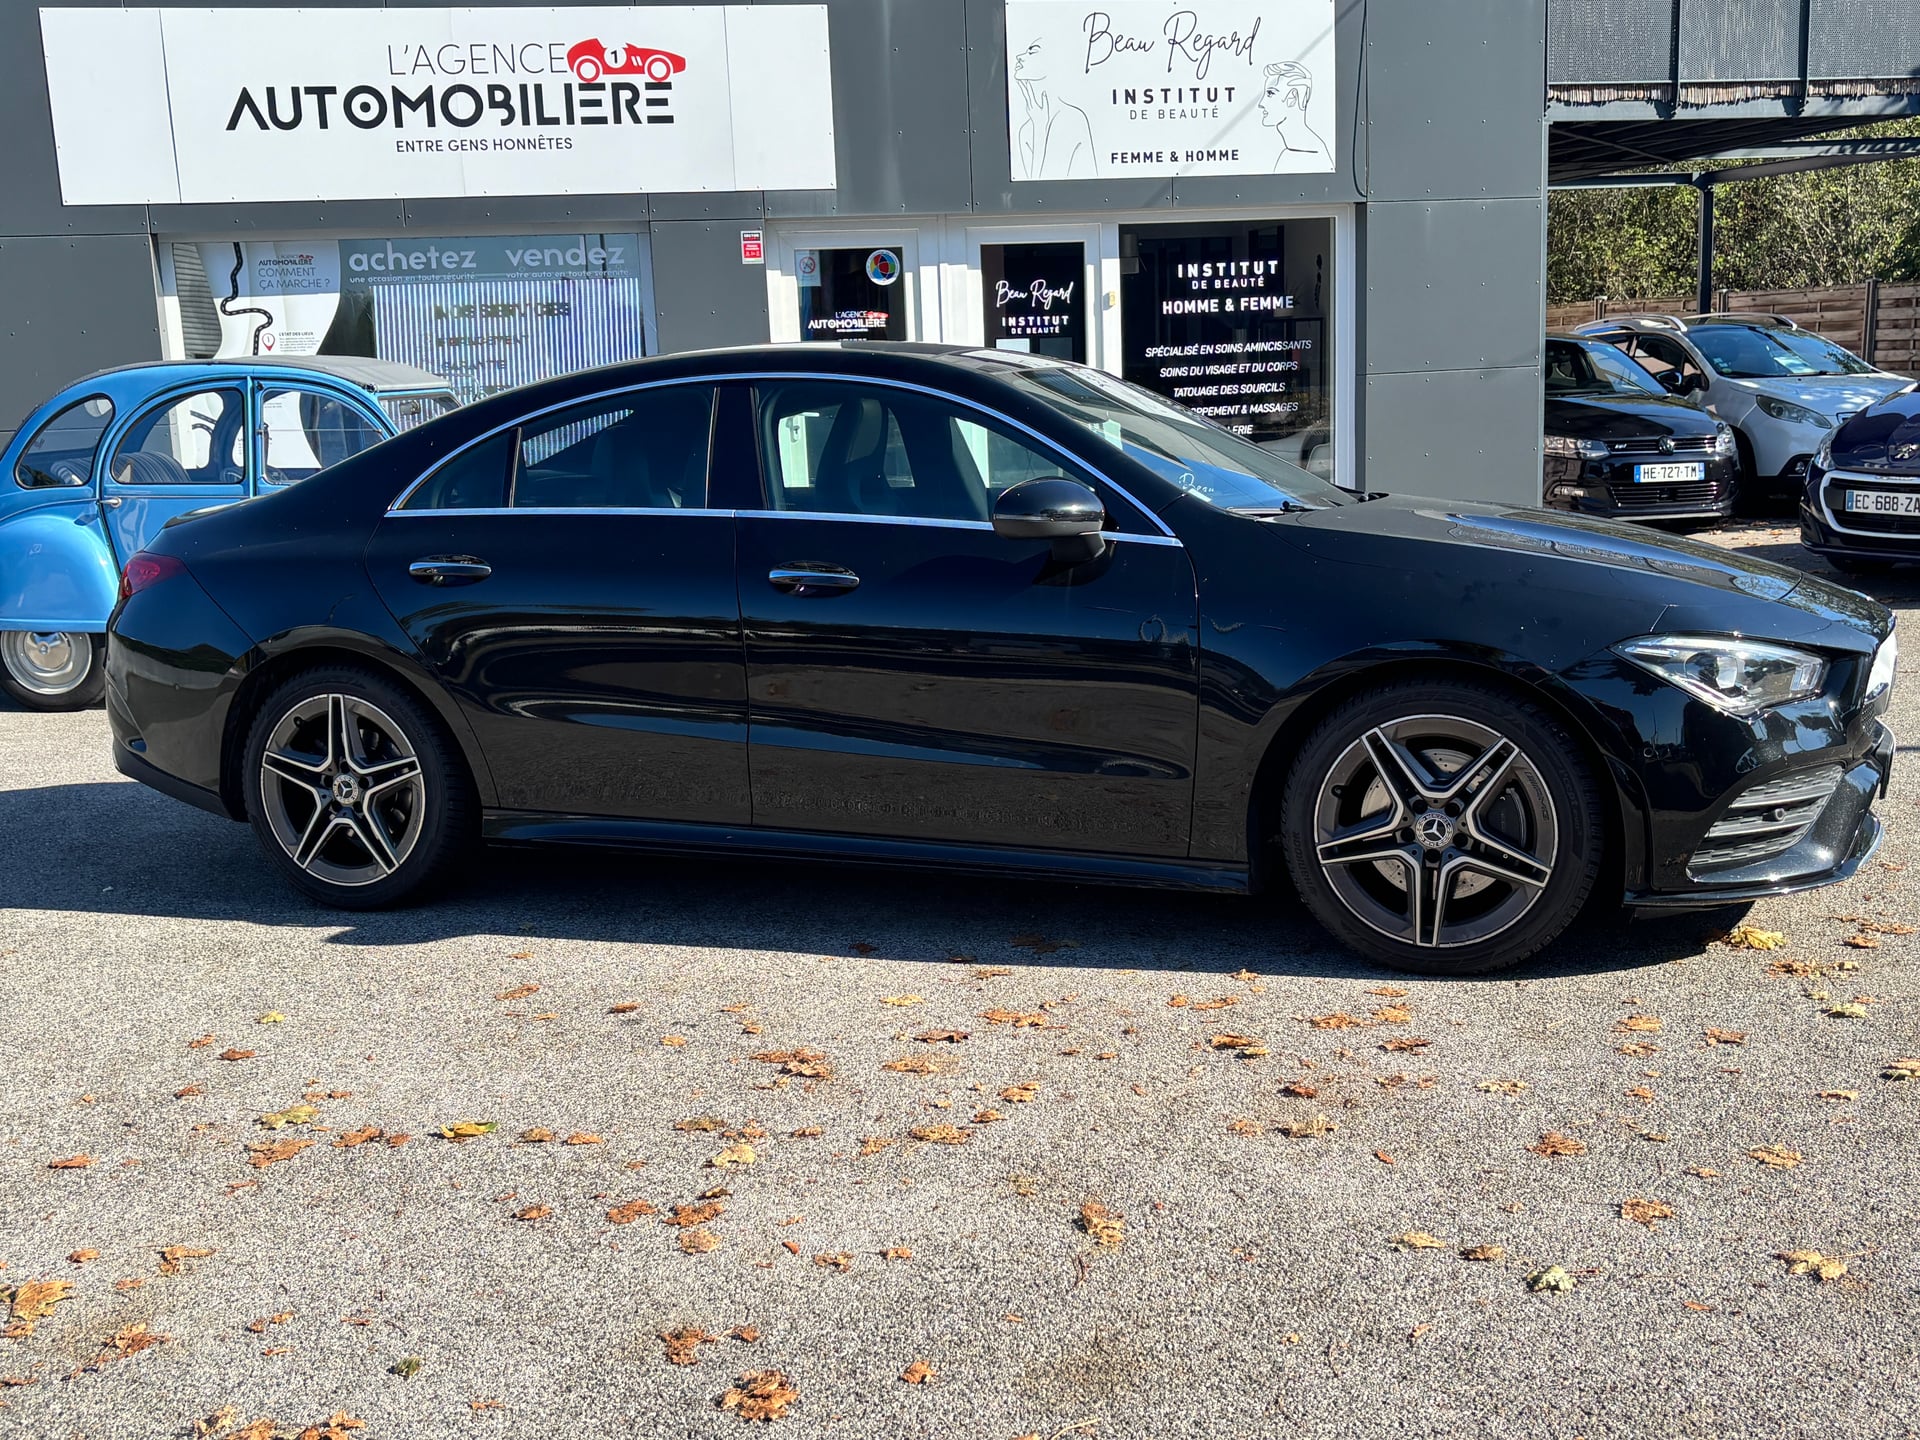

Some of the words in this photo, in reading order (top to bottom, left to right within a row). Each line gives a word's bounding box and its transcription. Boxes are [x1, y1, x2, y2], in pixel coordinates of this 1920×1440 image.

[1083, 11, 1155, 74] Beau
[1163, 10, 1261, 80] Regard
[387, 43, 568, 76] L'AGENCE
[1112, 87, 1236, 105] INSTITUT
[1129, 109, 1148, 120] DE
[1158, 106, 1219, 119] BEAUTÉ
[396, 139, 443, 153] ENTRE
[448, 138, 489, 152] GENS
[493, 134, 573, 151] HONNÊTES
[1111, 152, 1164, 164] FEMME
[1170, 151, 1179, 163] &
[1186, 150, 1239, 162] HOMME
[349, 241, 477, 271] achetez
[505, 239, 625, 266] vendez
[258, 267, 316, 278] COMMENT
[368, 273, 403, 282] occasion
[443, 271, 475, 280] sécurité
[1177, 260, 1279, 278] INSTITUT
[259, 280, 274, 290] ÇA
[276, 279, 322, 288] MARCHE
[324, 279, 330, 287] ?
[1191, 280, 1208, 290] DE
[1214, 276, 1265, 289] BEAUTÉ
[995, 280, 1028, 308] Beau
[1030, 279, 1074, 310] Regard
[1162, 299, 1220, 315] HOMME
[1224, 298, 1235, 312] &
[1240, 295, 1294, 311] FEMME
[835, 310, 868, 319] L'AGENCE
[1001, 315, 1069, 327] INSTITUT
[1026, 325, 1060, 334] BEAUTÉ
[1145, 343, 1199, 357] SPÉCIALISÉ
[1200, 345, 1214, 354] EN
[1214, 343, 1243, 354] SOINS
[1244, 340, 1312, 352] AMINCISSANTS
[1160, 367, 1188, 377] SOINS
[1190, 365, 1203, 375] DU
[1205, 364, 1237, 375] VISAGE
[1239, 363, 1250, 373] ET
[1252, 363, 1265, 372] DU
[1267, 361, 1298, 372] CORPS
[1173, 386, 1218, 397] TATOUAGE
[1220, 385, 1239, 394] DES
[1240, 382, 1286, 393] SOURCILS
[1241, 405, 1247, 414] &
[1250, 402, 1298, 413] MASSAGES
[1642, 466, 1697, 479] HE-727-TM
[1855, 493, 1920, 513] EC-688-ZA
